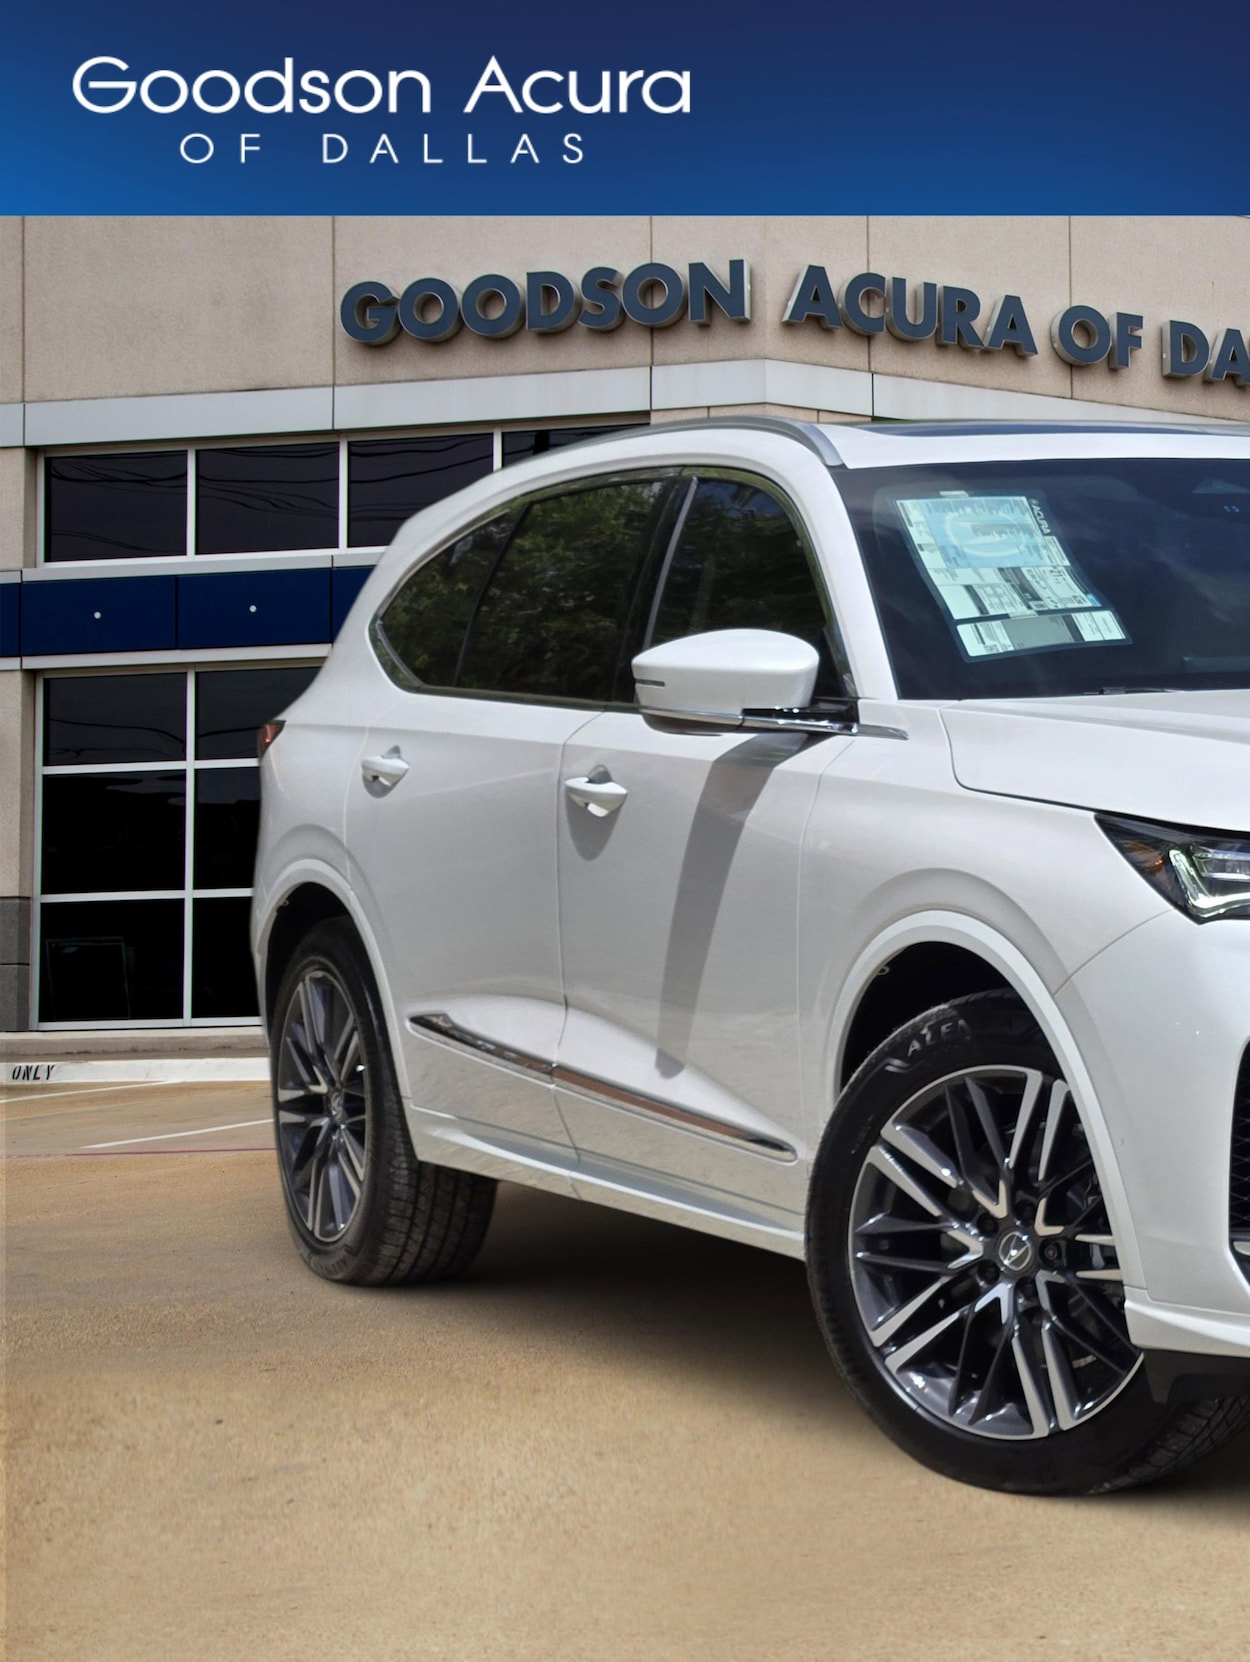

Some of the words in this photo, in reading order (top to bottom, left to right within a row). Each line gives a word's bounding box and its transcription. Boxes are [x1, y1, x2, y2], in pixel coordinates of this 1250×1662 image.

[340, 259, 752, 347] GOODSON
[782, 264, 1039, 357] ACURA
[1051, 305, 1143, 370] OF
[1031, 504, 1051, 535] ACURA
[12, 1064, 55, 1081] ONLY
